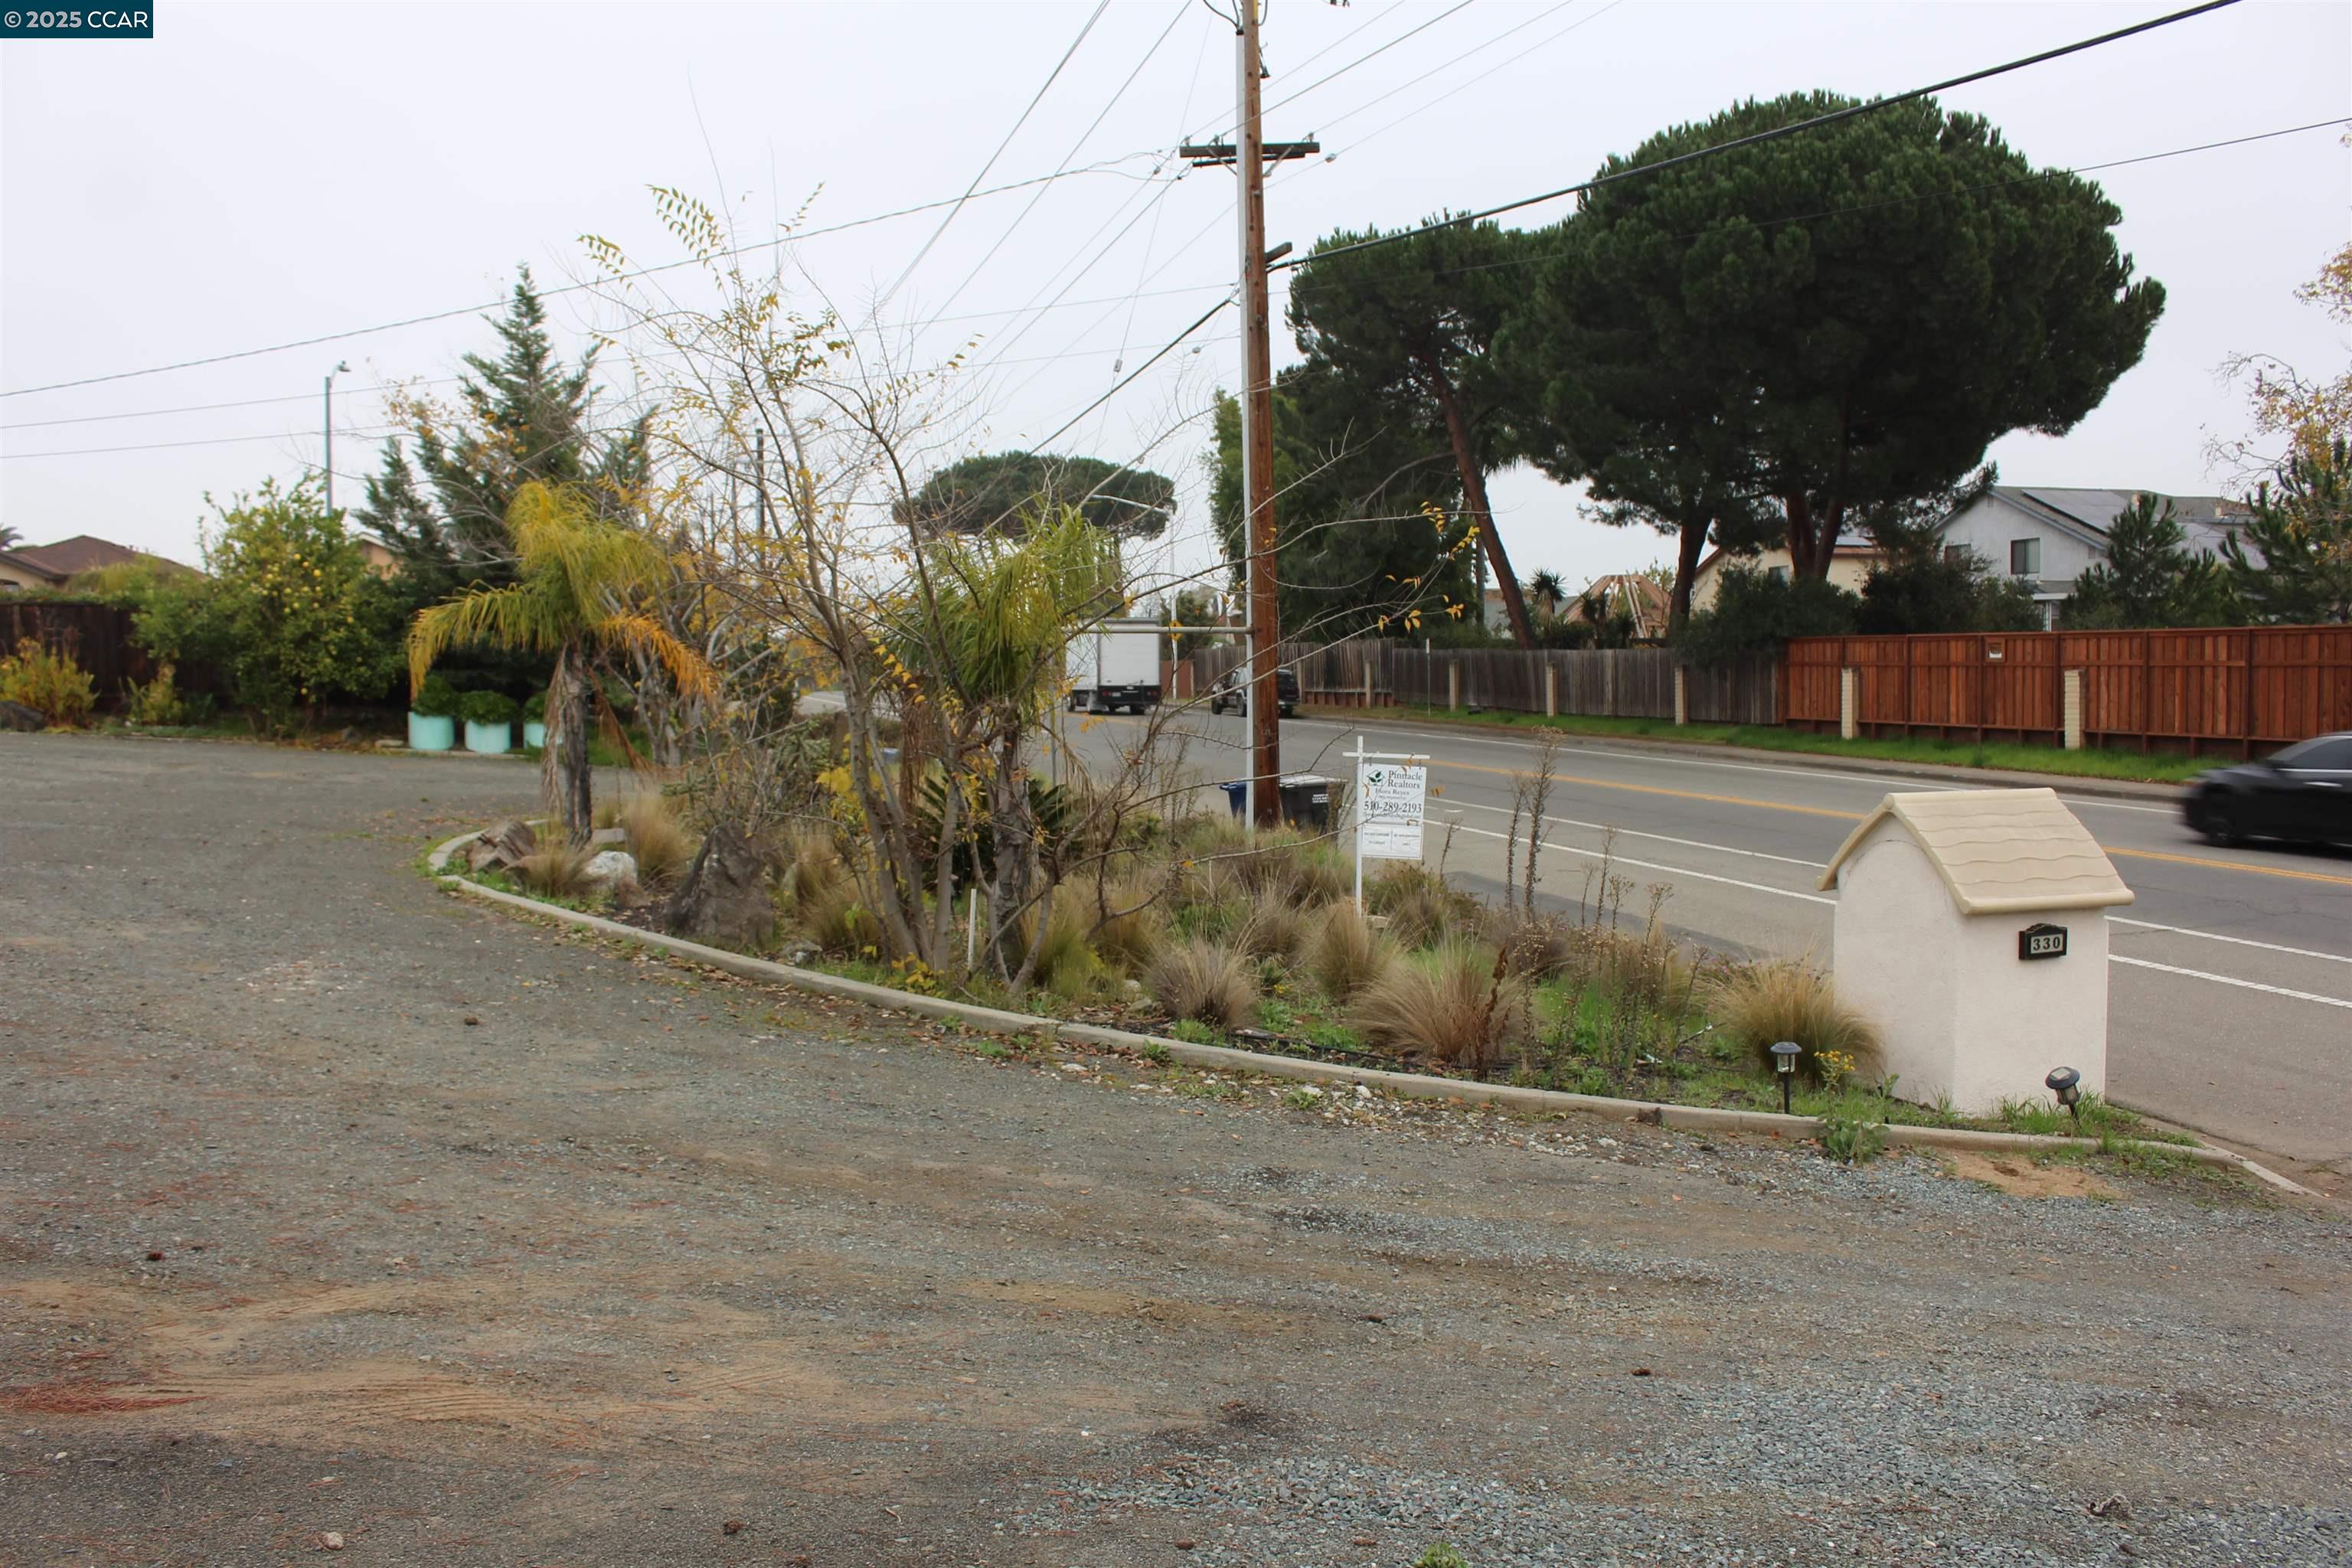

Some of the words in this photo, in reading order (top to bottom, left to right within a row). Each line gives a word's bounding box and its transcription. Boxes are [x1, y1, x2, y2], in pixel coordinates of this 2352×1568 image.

[1388, 770, 1423, 781] Pinnacle
[1387, 779, 1420, 789] Realtors
[1364, 801, 1422, 813] 510-289-2193
[2033, 936, 2060, 951] 330
